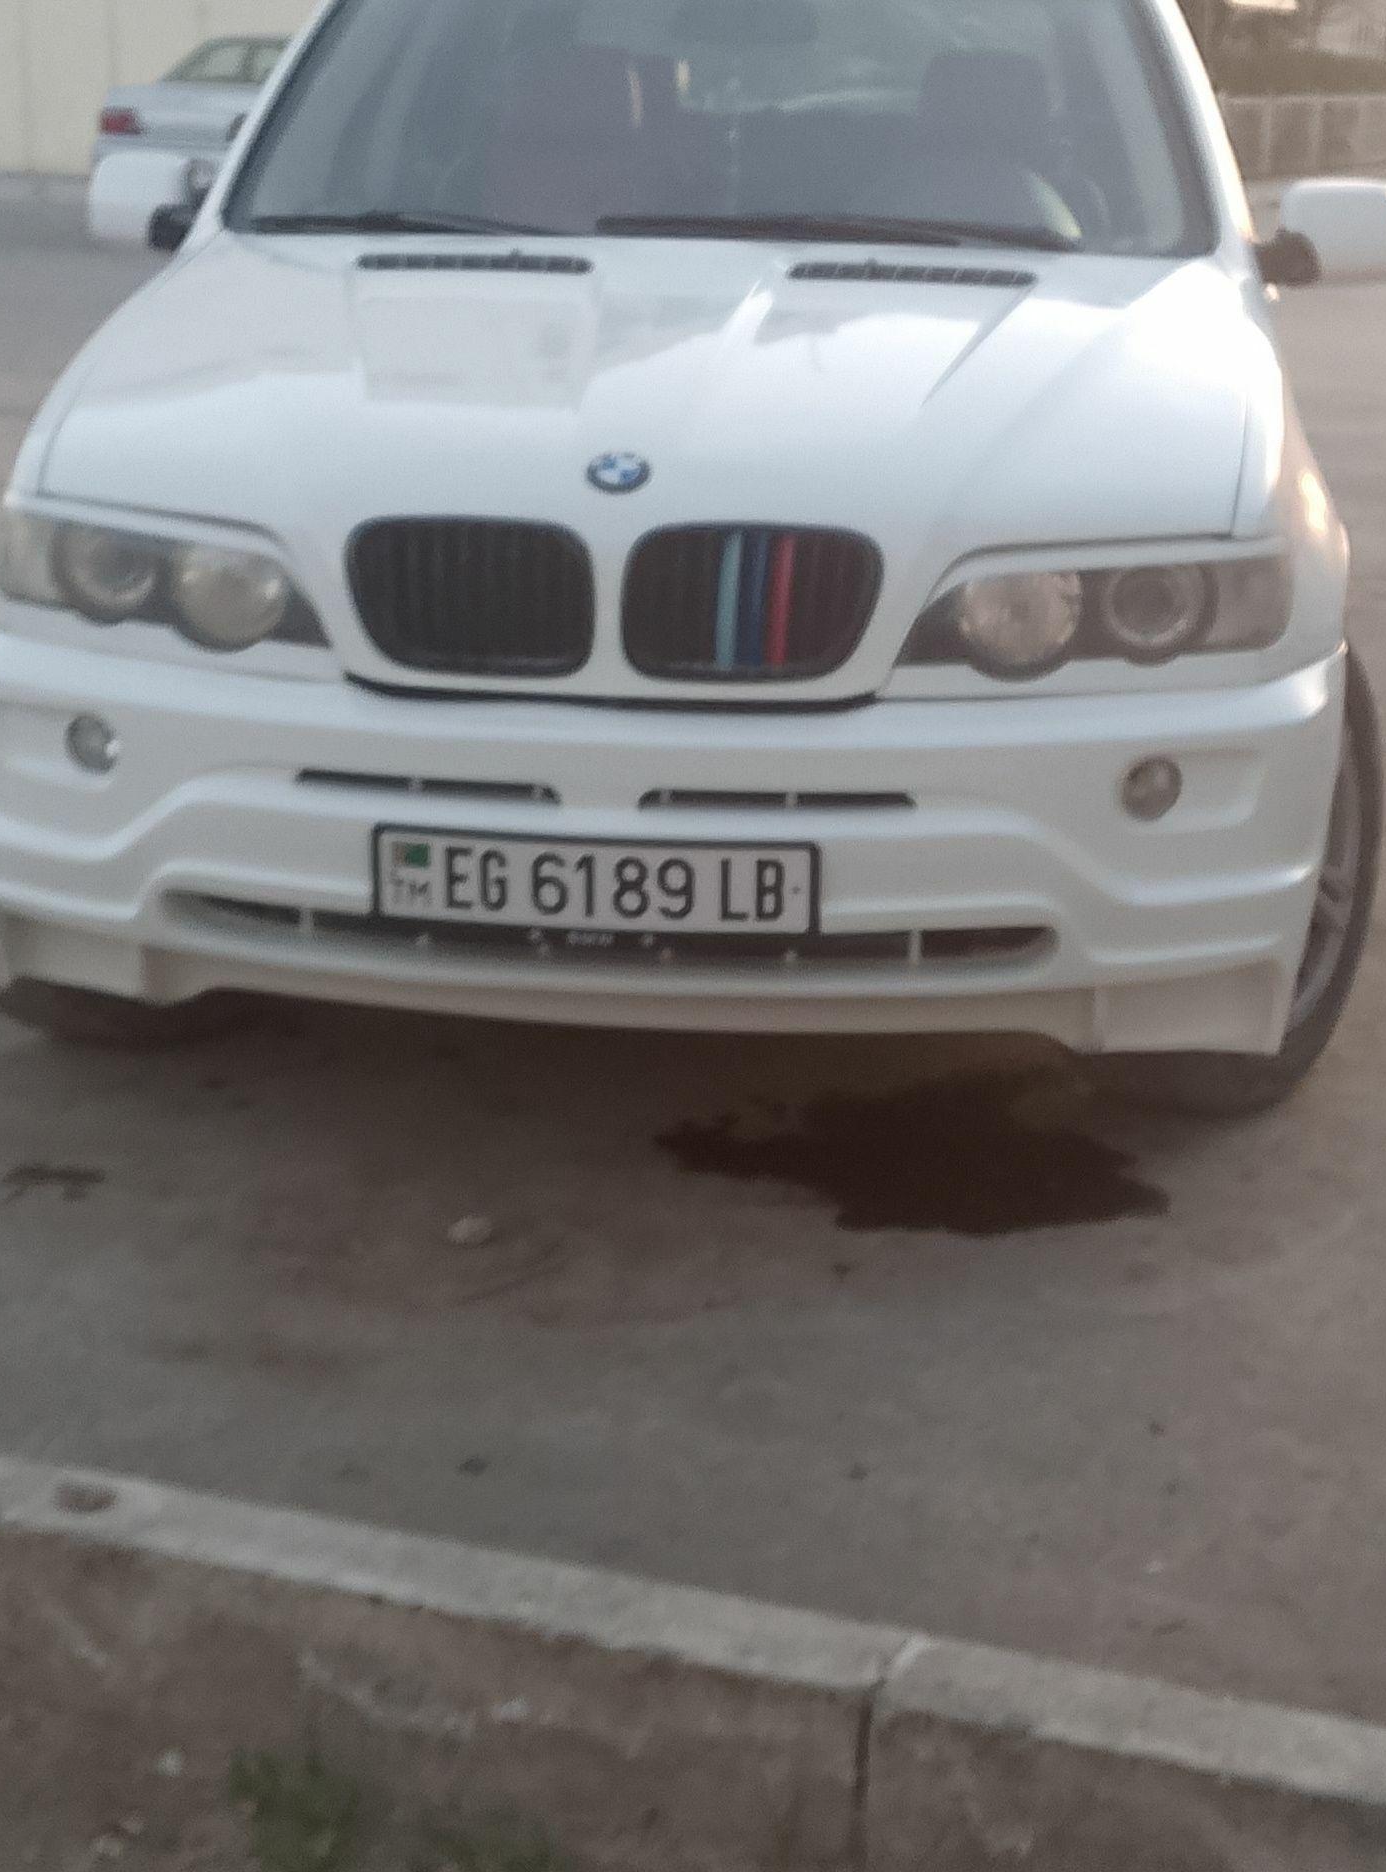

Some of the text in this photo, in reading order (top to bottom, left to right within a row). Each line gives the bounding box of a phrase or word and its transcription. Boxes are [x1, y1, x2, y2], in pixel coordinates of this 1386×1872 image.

[445, 846, 784, 922] EG 6189 LB
